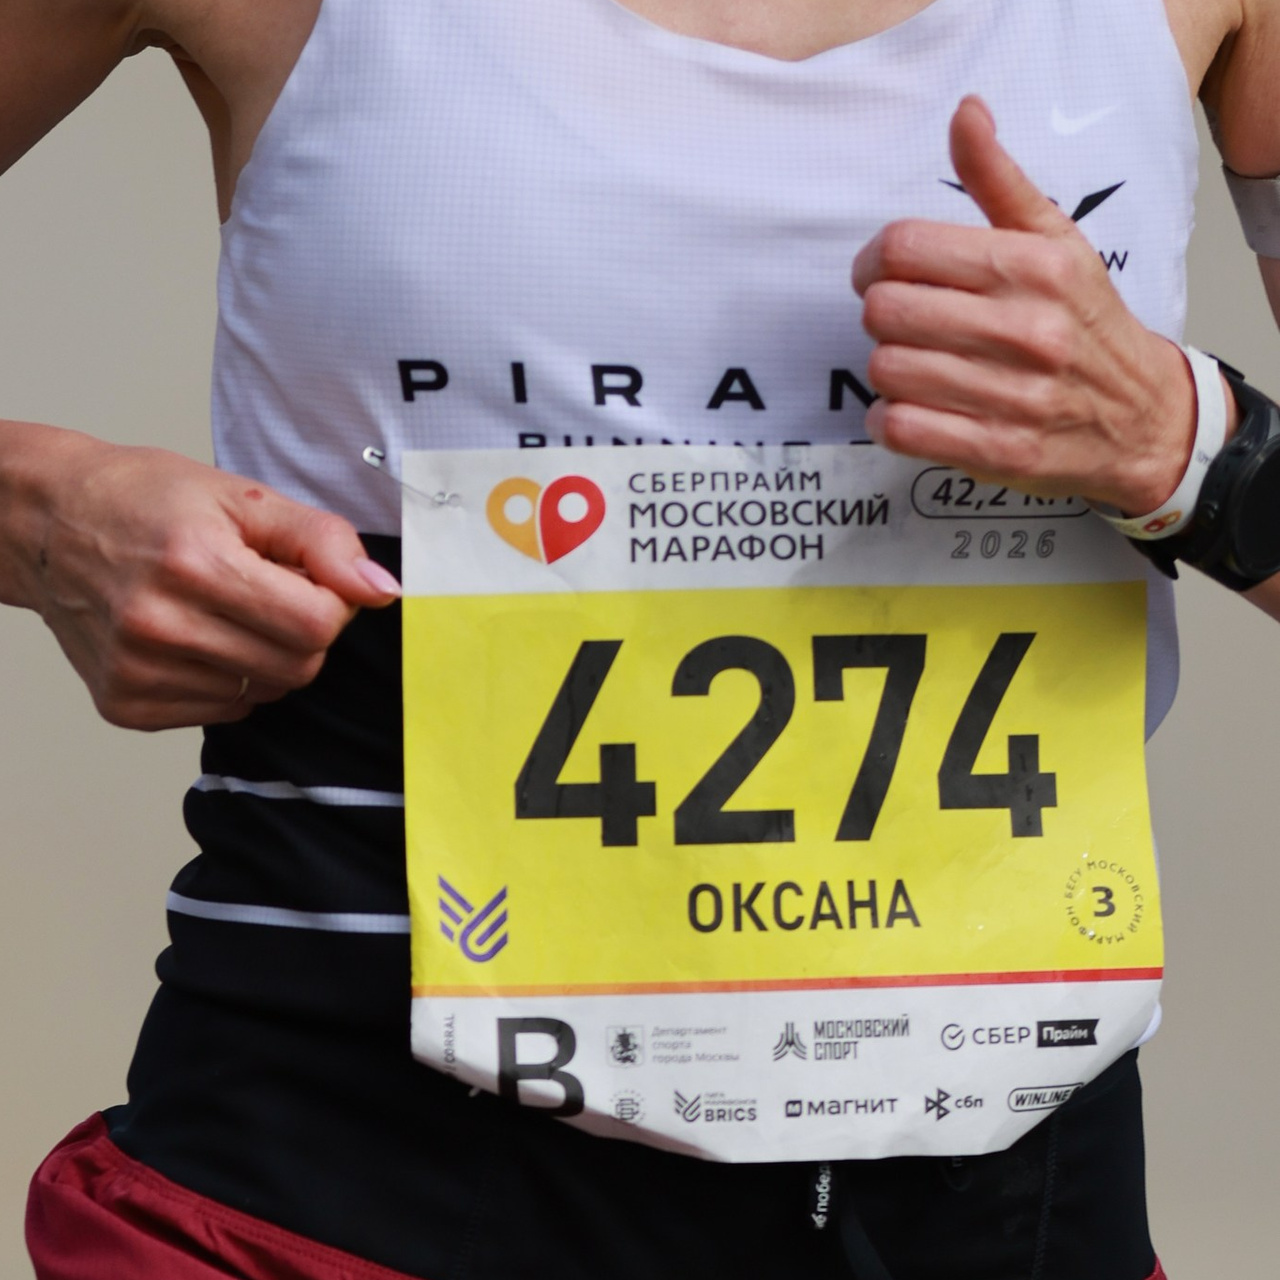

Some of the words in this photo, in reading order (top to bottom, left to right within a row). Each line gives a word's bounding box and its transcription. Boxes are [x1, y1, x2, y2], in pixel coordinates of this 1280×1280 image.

[629, 467, 821, 493] СБЕРПРАЙМ
[932, 477, 1009, 511] 42,2
[630, 493, 890, 528] МОСКОВСКИЙ
[630, 533, 824, 564] МАРАФОН
[951, 530, 1056, 559] 2026
[514, 631, 1058, 847] 4274
[687, 878, 922, 934] ОКСАНА
[1091, 885, 1117, 918] 3
[443, 1013, 455, 1063] CORRAL
[813, 1014, 910, 1039] МОСКОВСКИЙ
[972, 1026, 1031, 1045] СБЕР
[1042, 1025, 1088, 1043] Прайм
[814, 1040, 859, 1061] СПОРТ
[1015, 1089, 1070, 1106] WINLINE
[705, 1107, 757, 1122] BRICS
